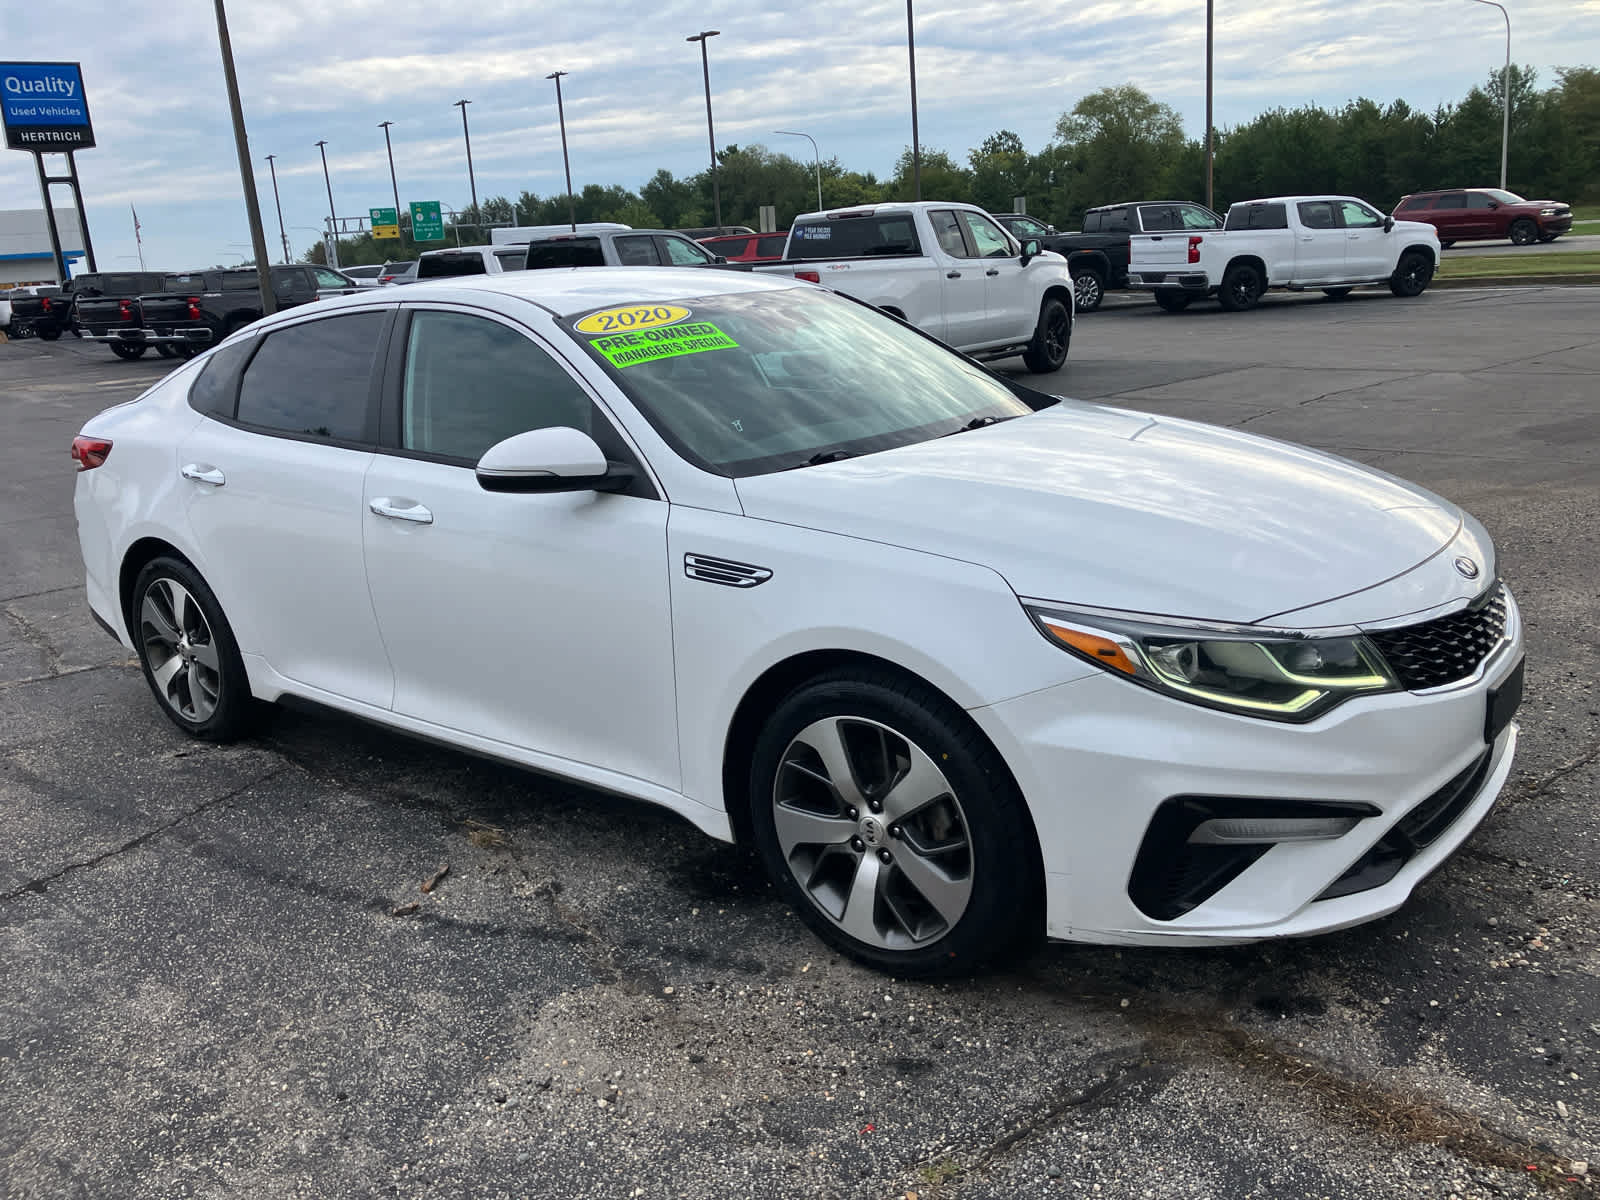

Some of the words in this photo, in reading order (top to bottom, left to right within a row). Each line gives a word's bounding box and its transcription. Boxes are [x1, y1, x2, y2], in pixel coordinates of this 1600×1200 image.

[5, 76, 75, 97] Quality
[10, 107, 37, 116] Used
[39, 107, 81, 116] Vehicles
[21, 131, 81, 142] HERTRICH
[597, 307, 672, 331] 2020
[597, 326, 717, 352] PRE-OWNED
[612, 342, 686, 365] MANAGER'S
[683, 335, 731, 351] SPECIAL
